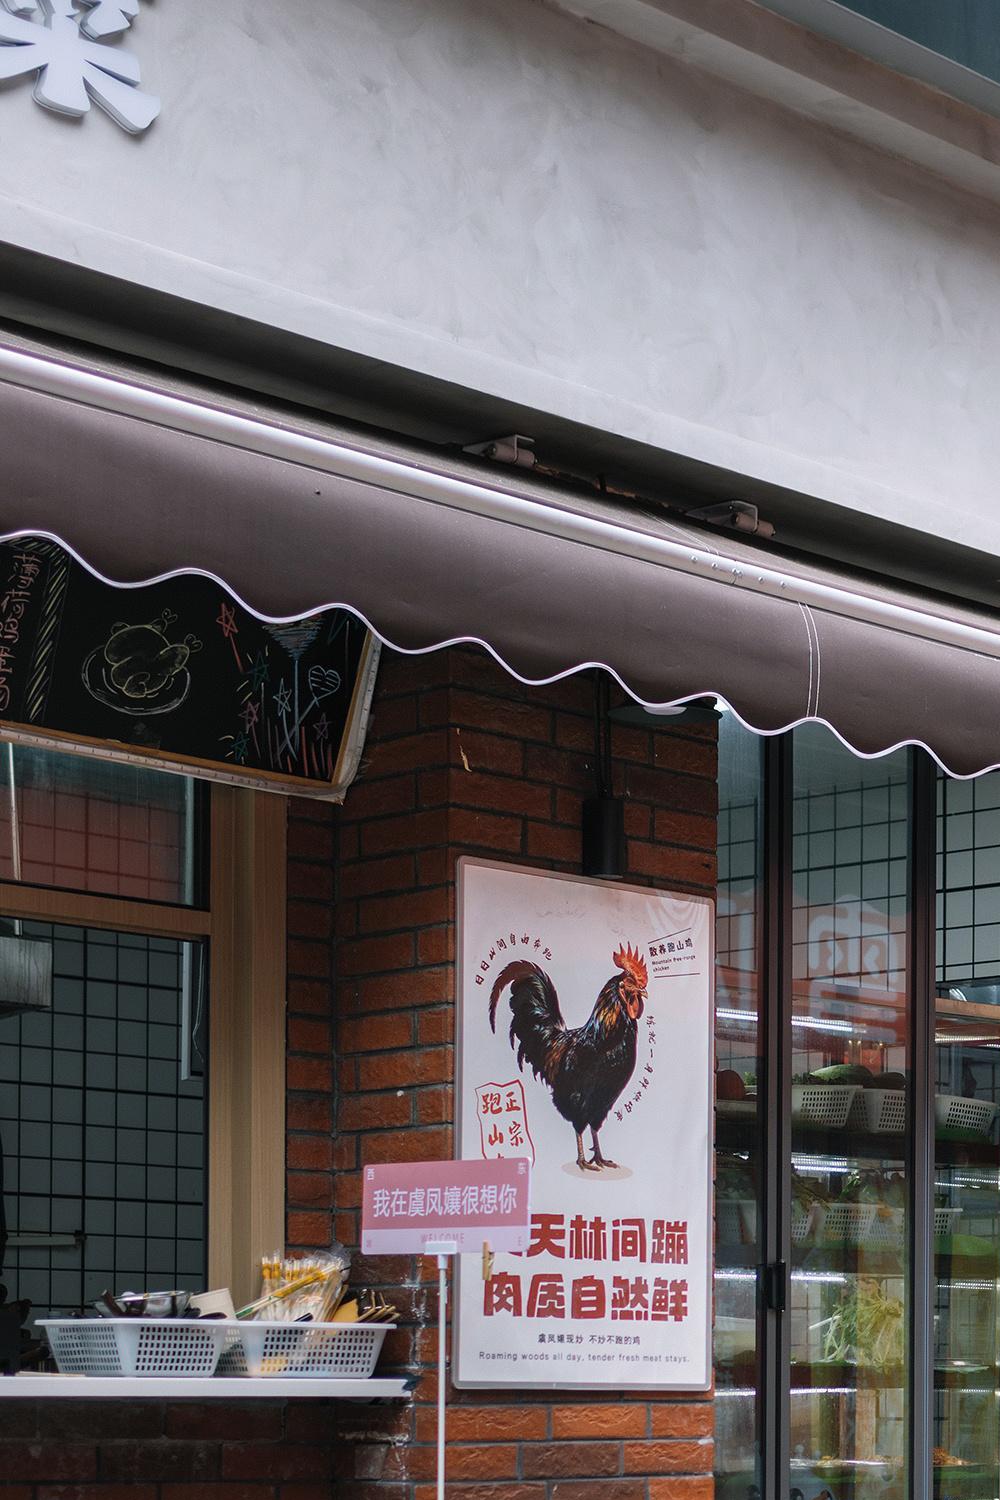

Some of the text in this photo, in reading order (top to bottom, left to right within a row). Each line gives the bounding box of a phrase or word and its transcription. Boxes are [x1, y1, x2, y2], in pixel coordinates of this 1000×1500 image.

[481, 1092, 504, 1159] 跑山
[373, 1184, 517, 1218] 我在虞凤孃很想你
[421, 1233, 465, 1244] WELCOME
[506, 1213, 689, 1265] 天林间蹦
[483, 1271, 689, 1322] 肉质自然鲜
[479, 1352, 690, 1364] Roaming woods all day, tender fresh meat stays.
